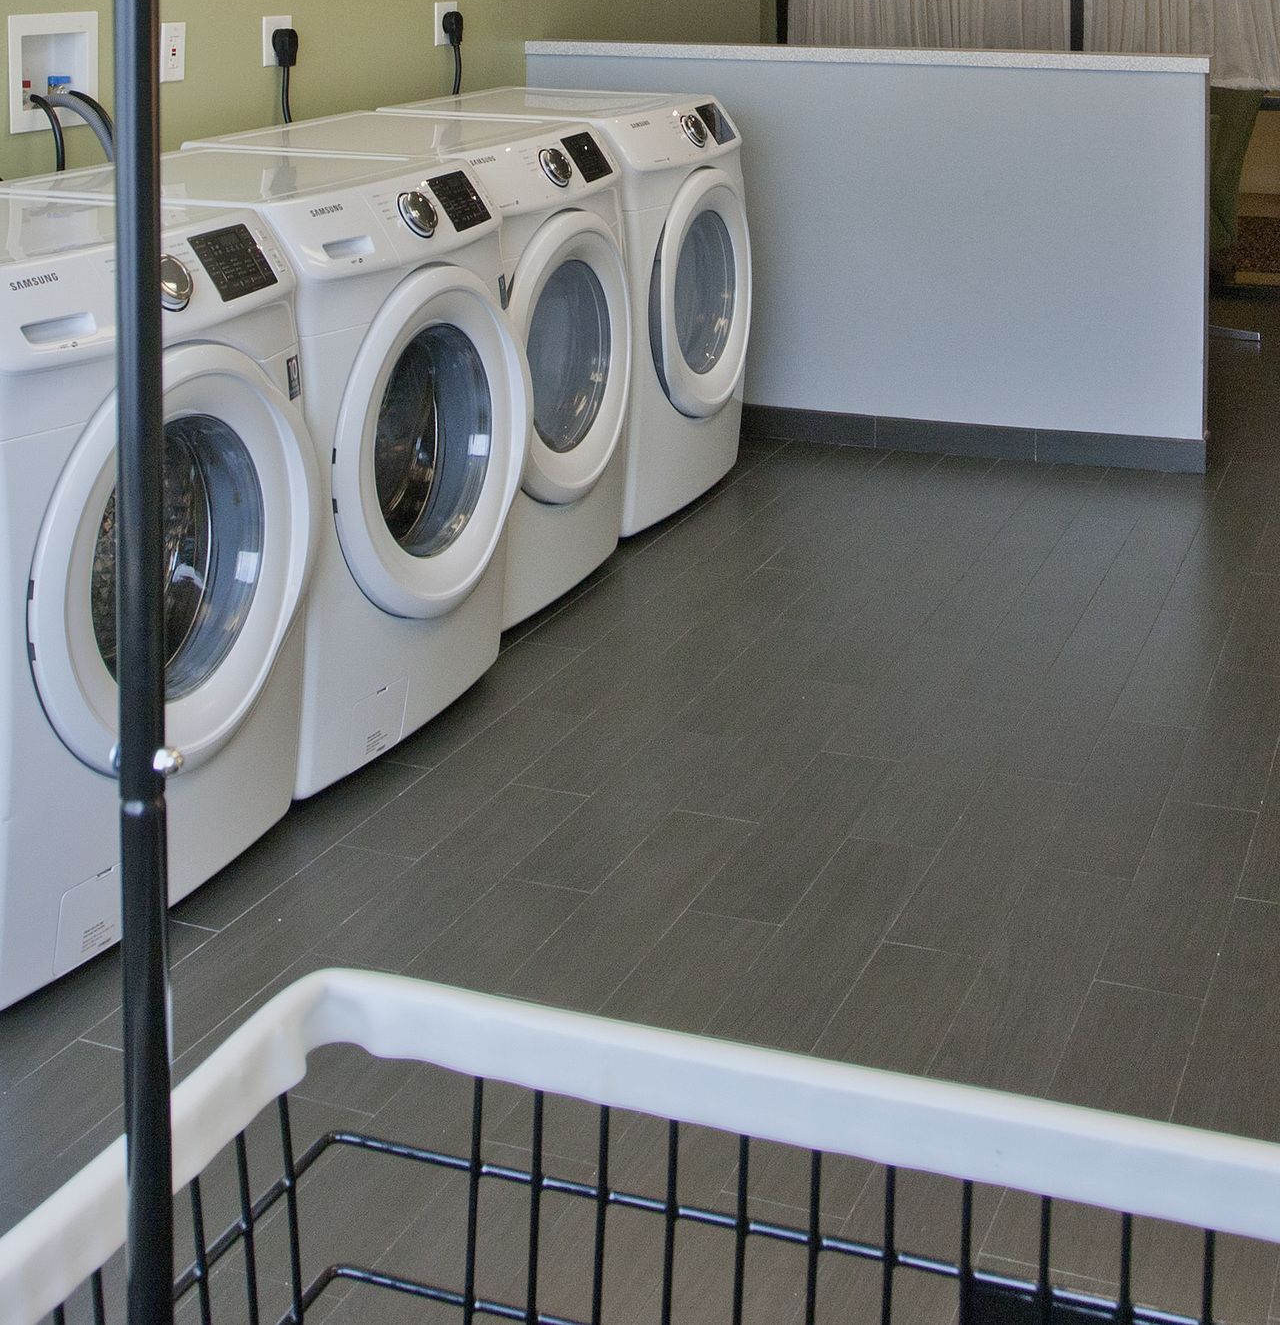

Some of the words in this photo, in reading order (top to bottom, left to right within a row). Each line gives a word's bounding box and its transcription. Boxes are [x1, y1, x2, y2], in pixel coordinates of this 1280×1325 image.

[470, 155, 497, 167] SAMSUNG
[310, 203, 344, 218] SAMSUNG
[9, 272, 59, 291] SAMSUNG
